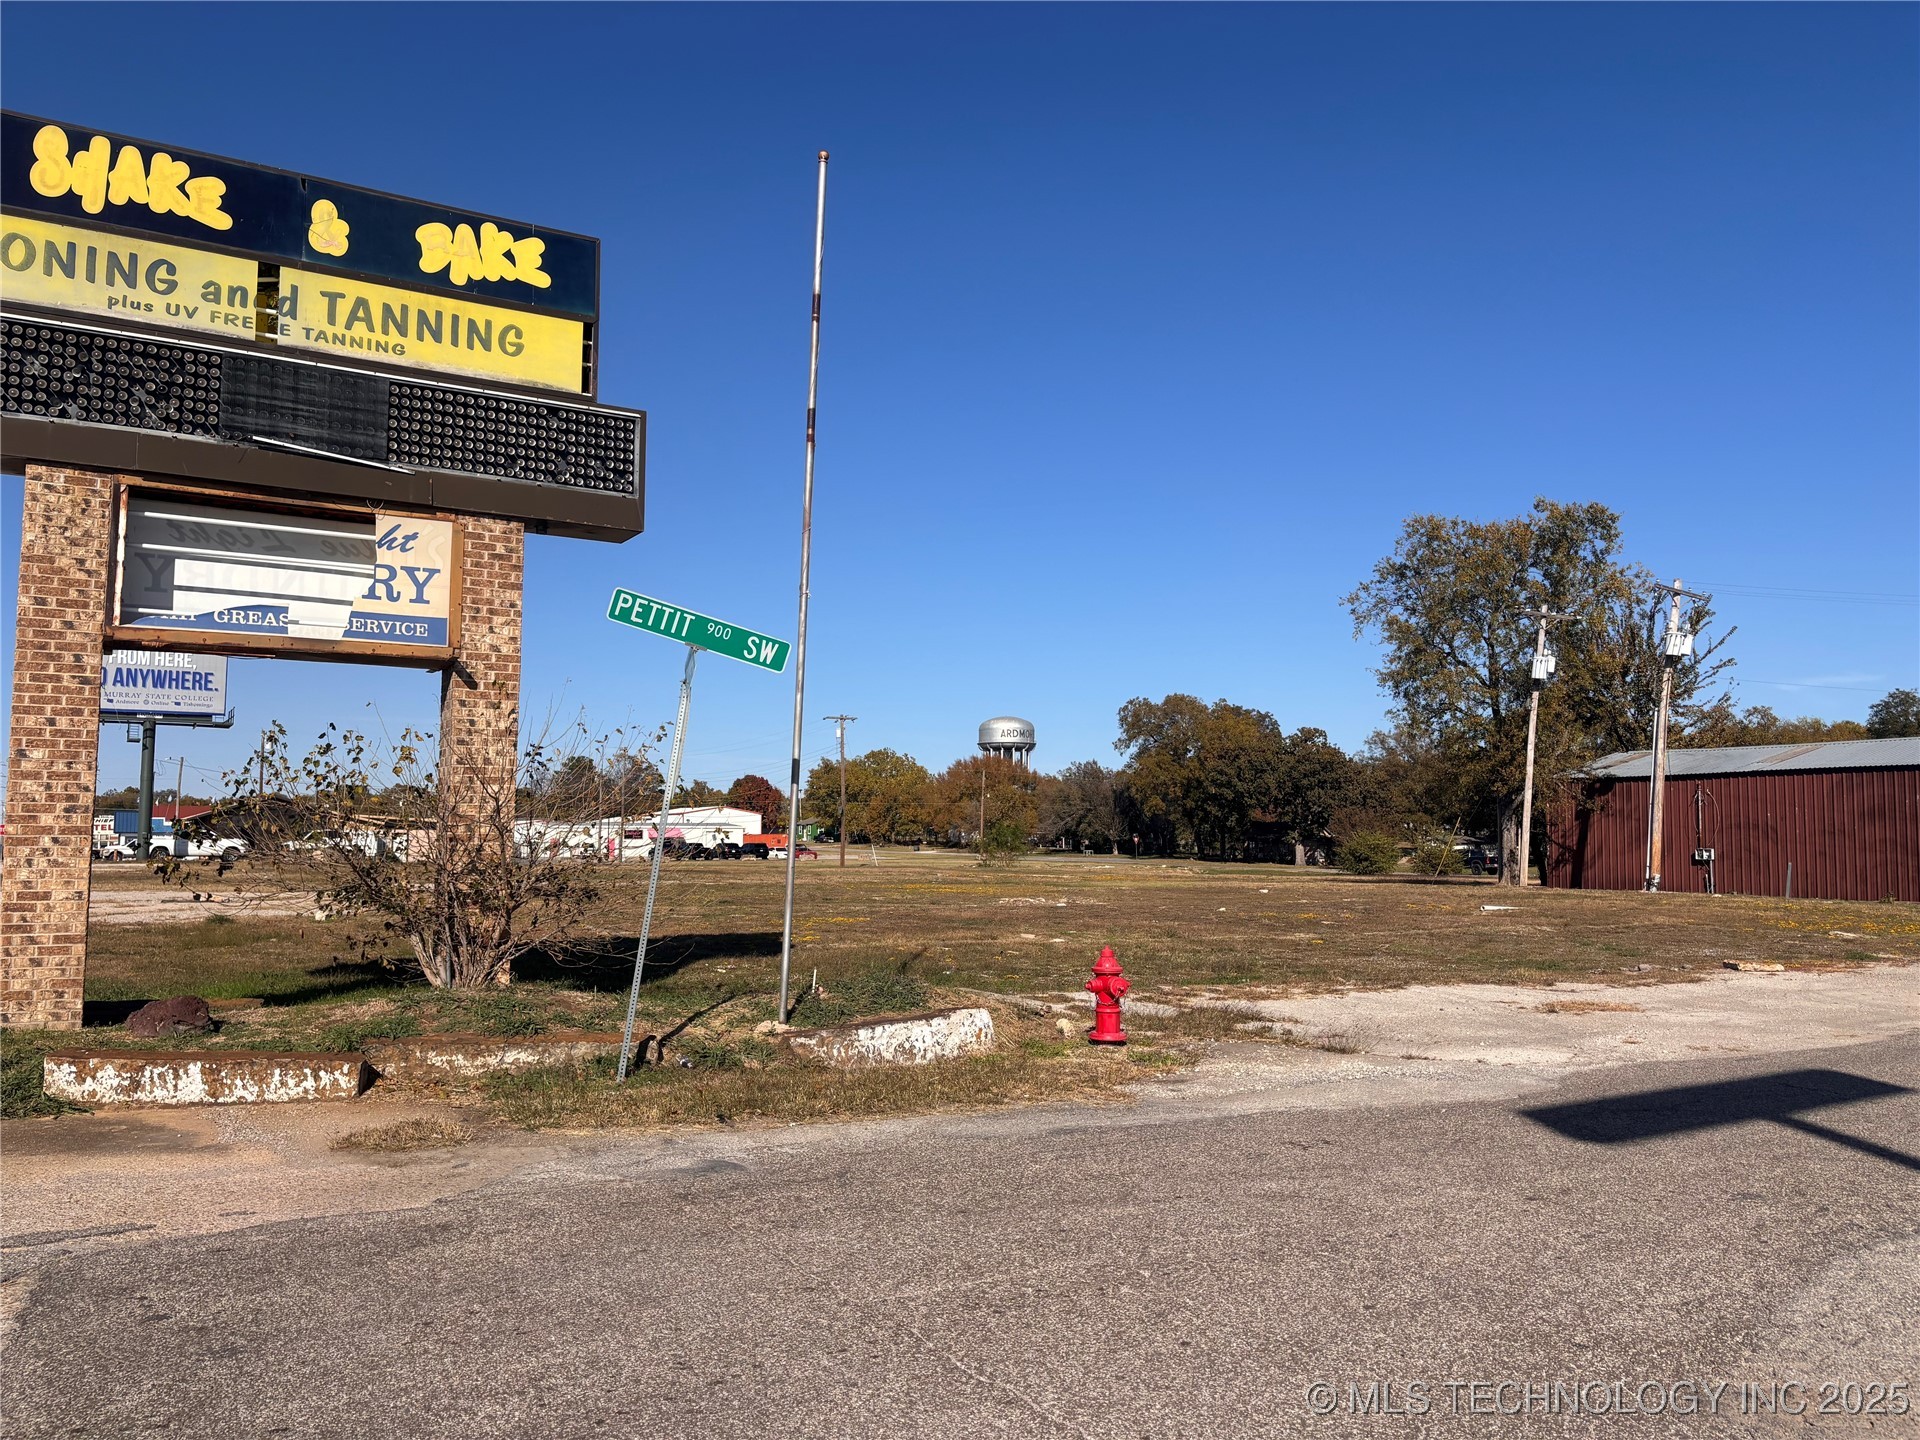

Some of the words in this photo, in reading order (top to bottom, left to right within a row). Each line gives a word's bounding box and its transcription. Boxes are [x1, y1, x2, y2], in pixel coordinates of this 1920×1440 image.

[30, 125, 233, 230] SHAKE
[304, 199, 350, 256] &
[415, 222, 552, 288] BAKE
[0, 232, 178, 296] ONING
[320, 290, 525, 357] TANNING
[107, 295, 154, 312] plus
[165, 302, 199, 319] UV
[301, 327, 406, 356] TANNING
[362, 563, 441, 605] RY
[614, 593, 696, 637] PETTIT
[707, 622, 732, 640] 900
[743, 636, 779, 665] SW
[112, 667, 219, 692] ANYWHERE.
[155, 652, 197, 671] HERE,
[104, 691, 142, 699] MURRAY
[145, 692, 172, 701] STATE
[174, 694, 214, 702] COLLEGE
